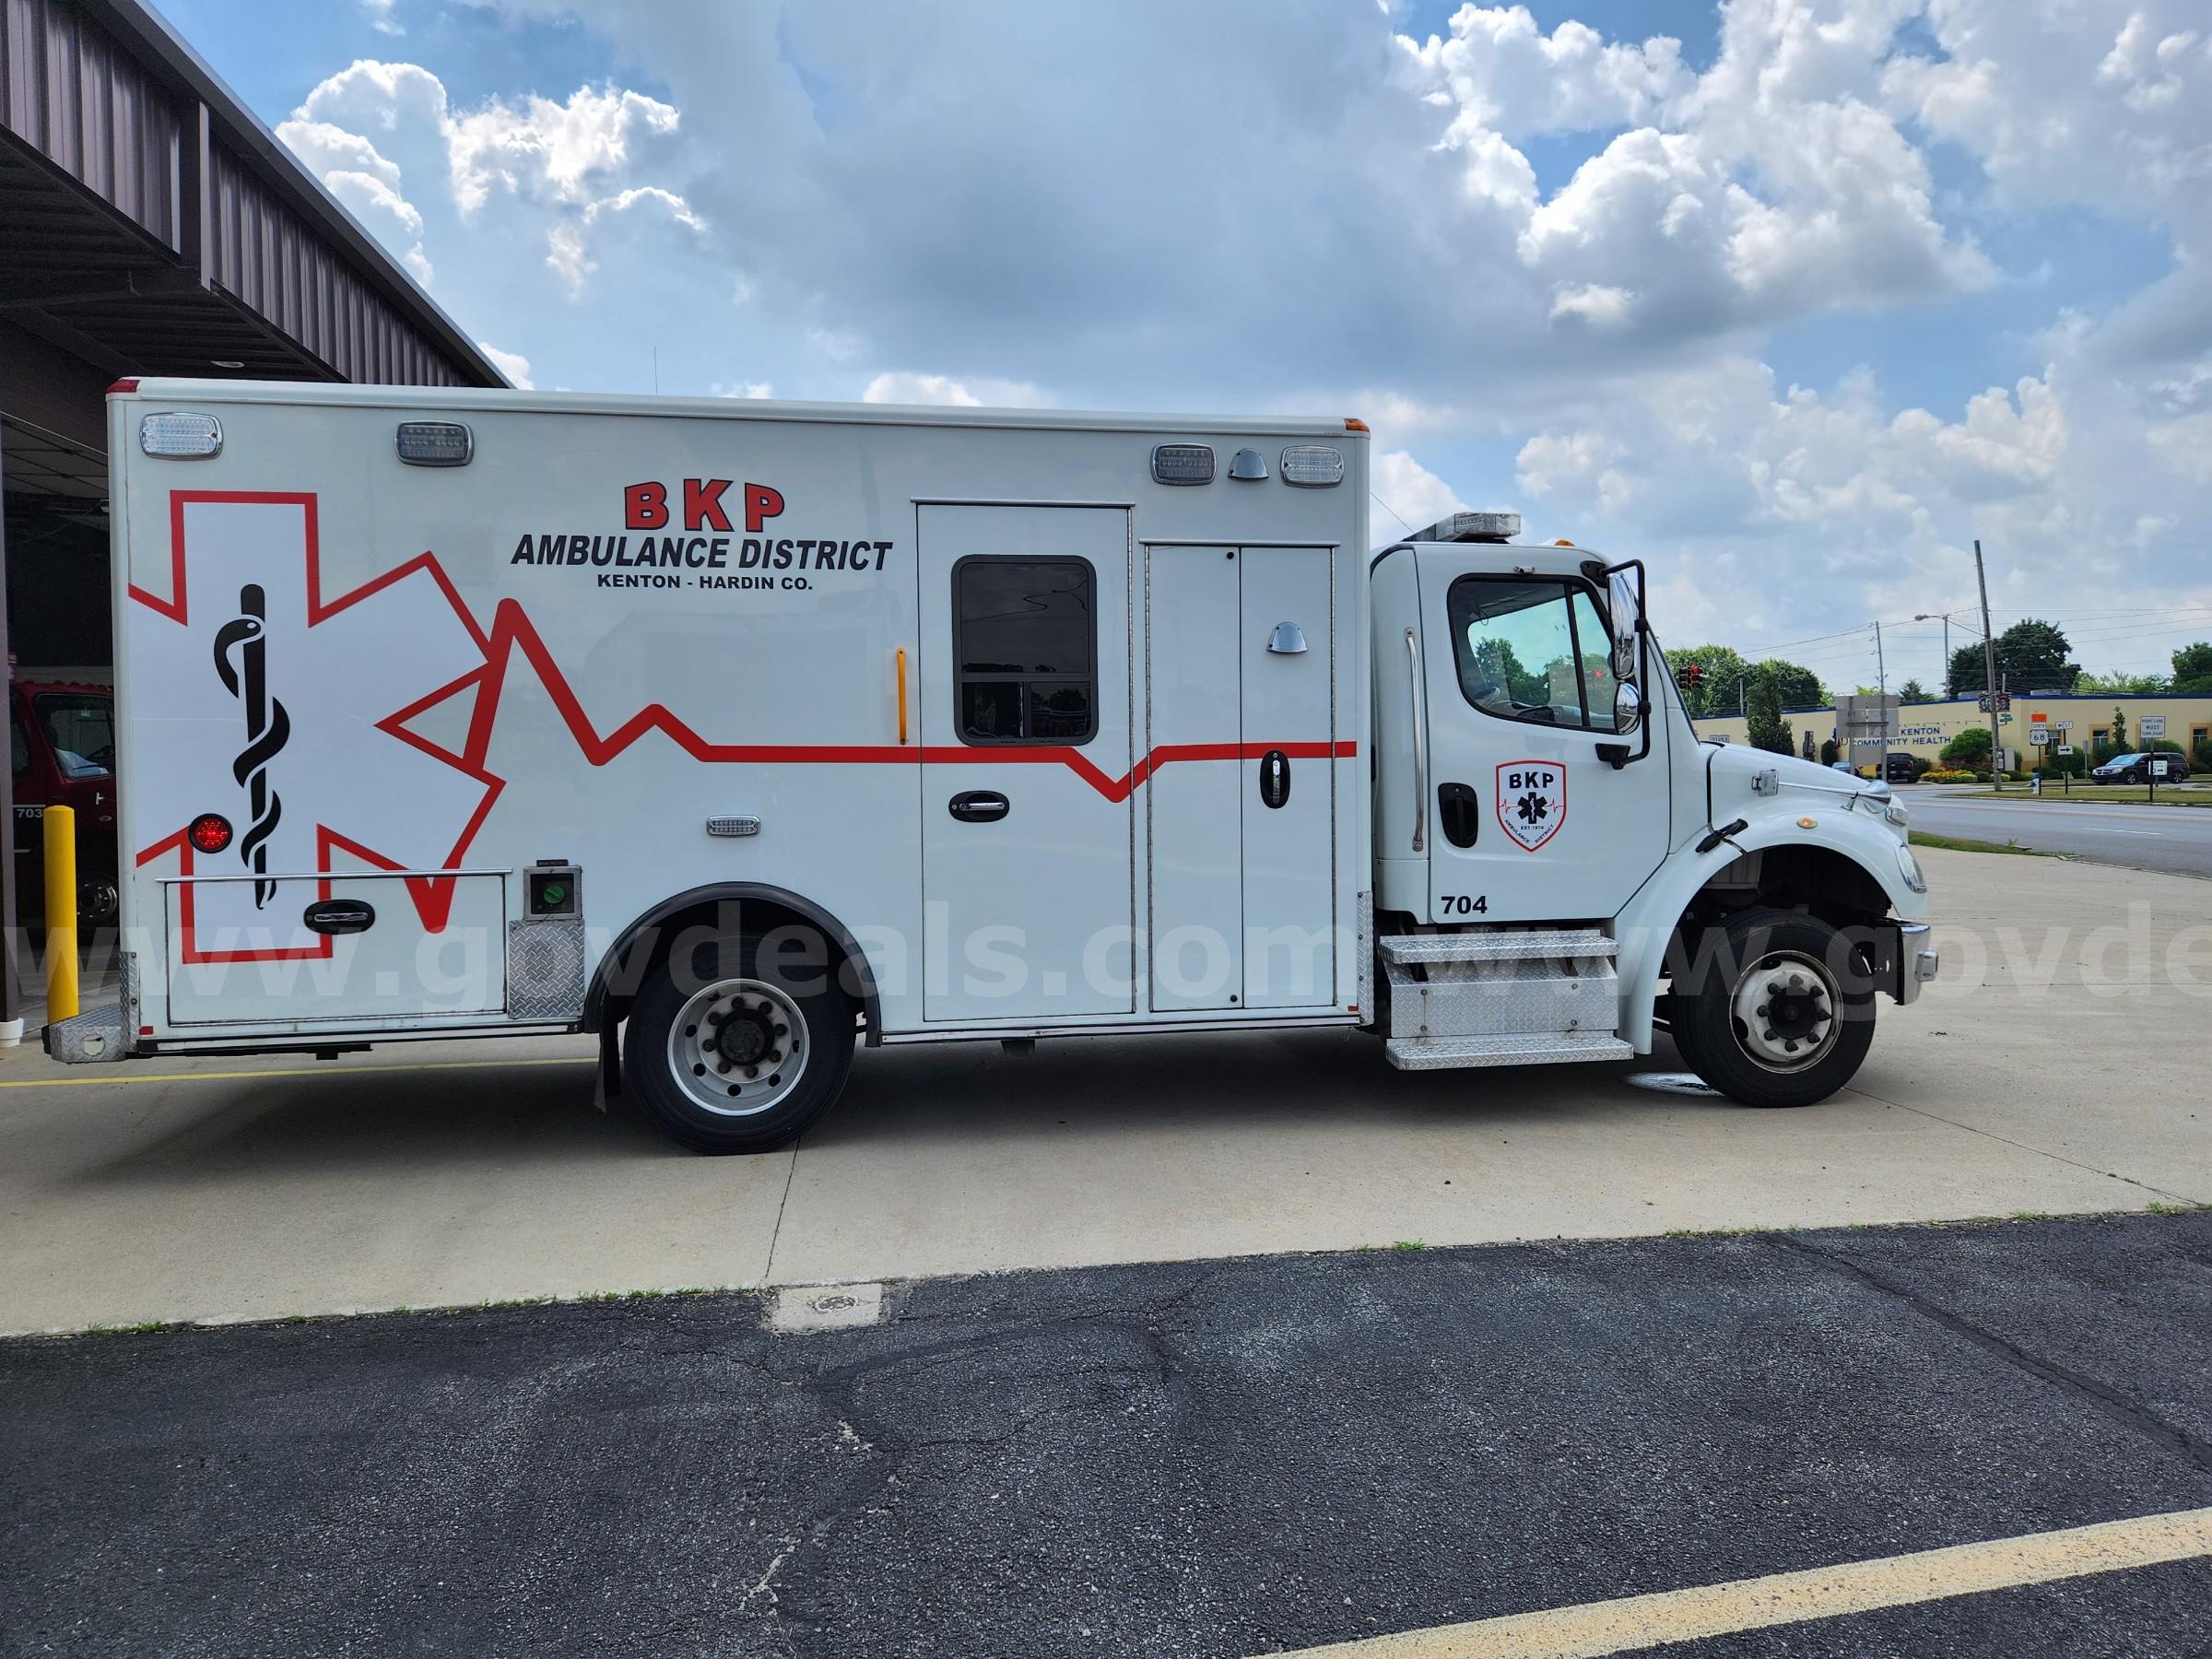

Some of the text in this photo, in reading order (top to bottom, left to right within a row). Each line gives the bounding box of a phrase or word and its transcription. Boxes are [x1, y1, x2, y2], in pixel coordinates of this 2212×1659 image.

[624, 478, 785, 533] BKP
[511, 534, 893, 571] AMBULANCE DISTRICT
[597, 574, 680, 589] KENTON
[700, 575, 774, 590] HARDIN
[781, 576, 813, 591] CO.
[1900, 727, 1940, 736] KENTON
[1912, 736, 1951, 746] HEALTH
[1509, 771, 1554, 789] BKP
[17, 808, 43, 818] 703
[1504, 819, 1555, 843] AMBULANCE DISTRICT
[1441, 895, 1488, 914] 704
